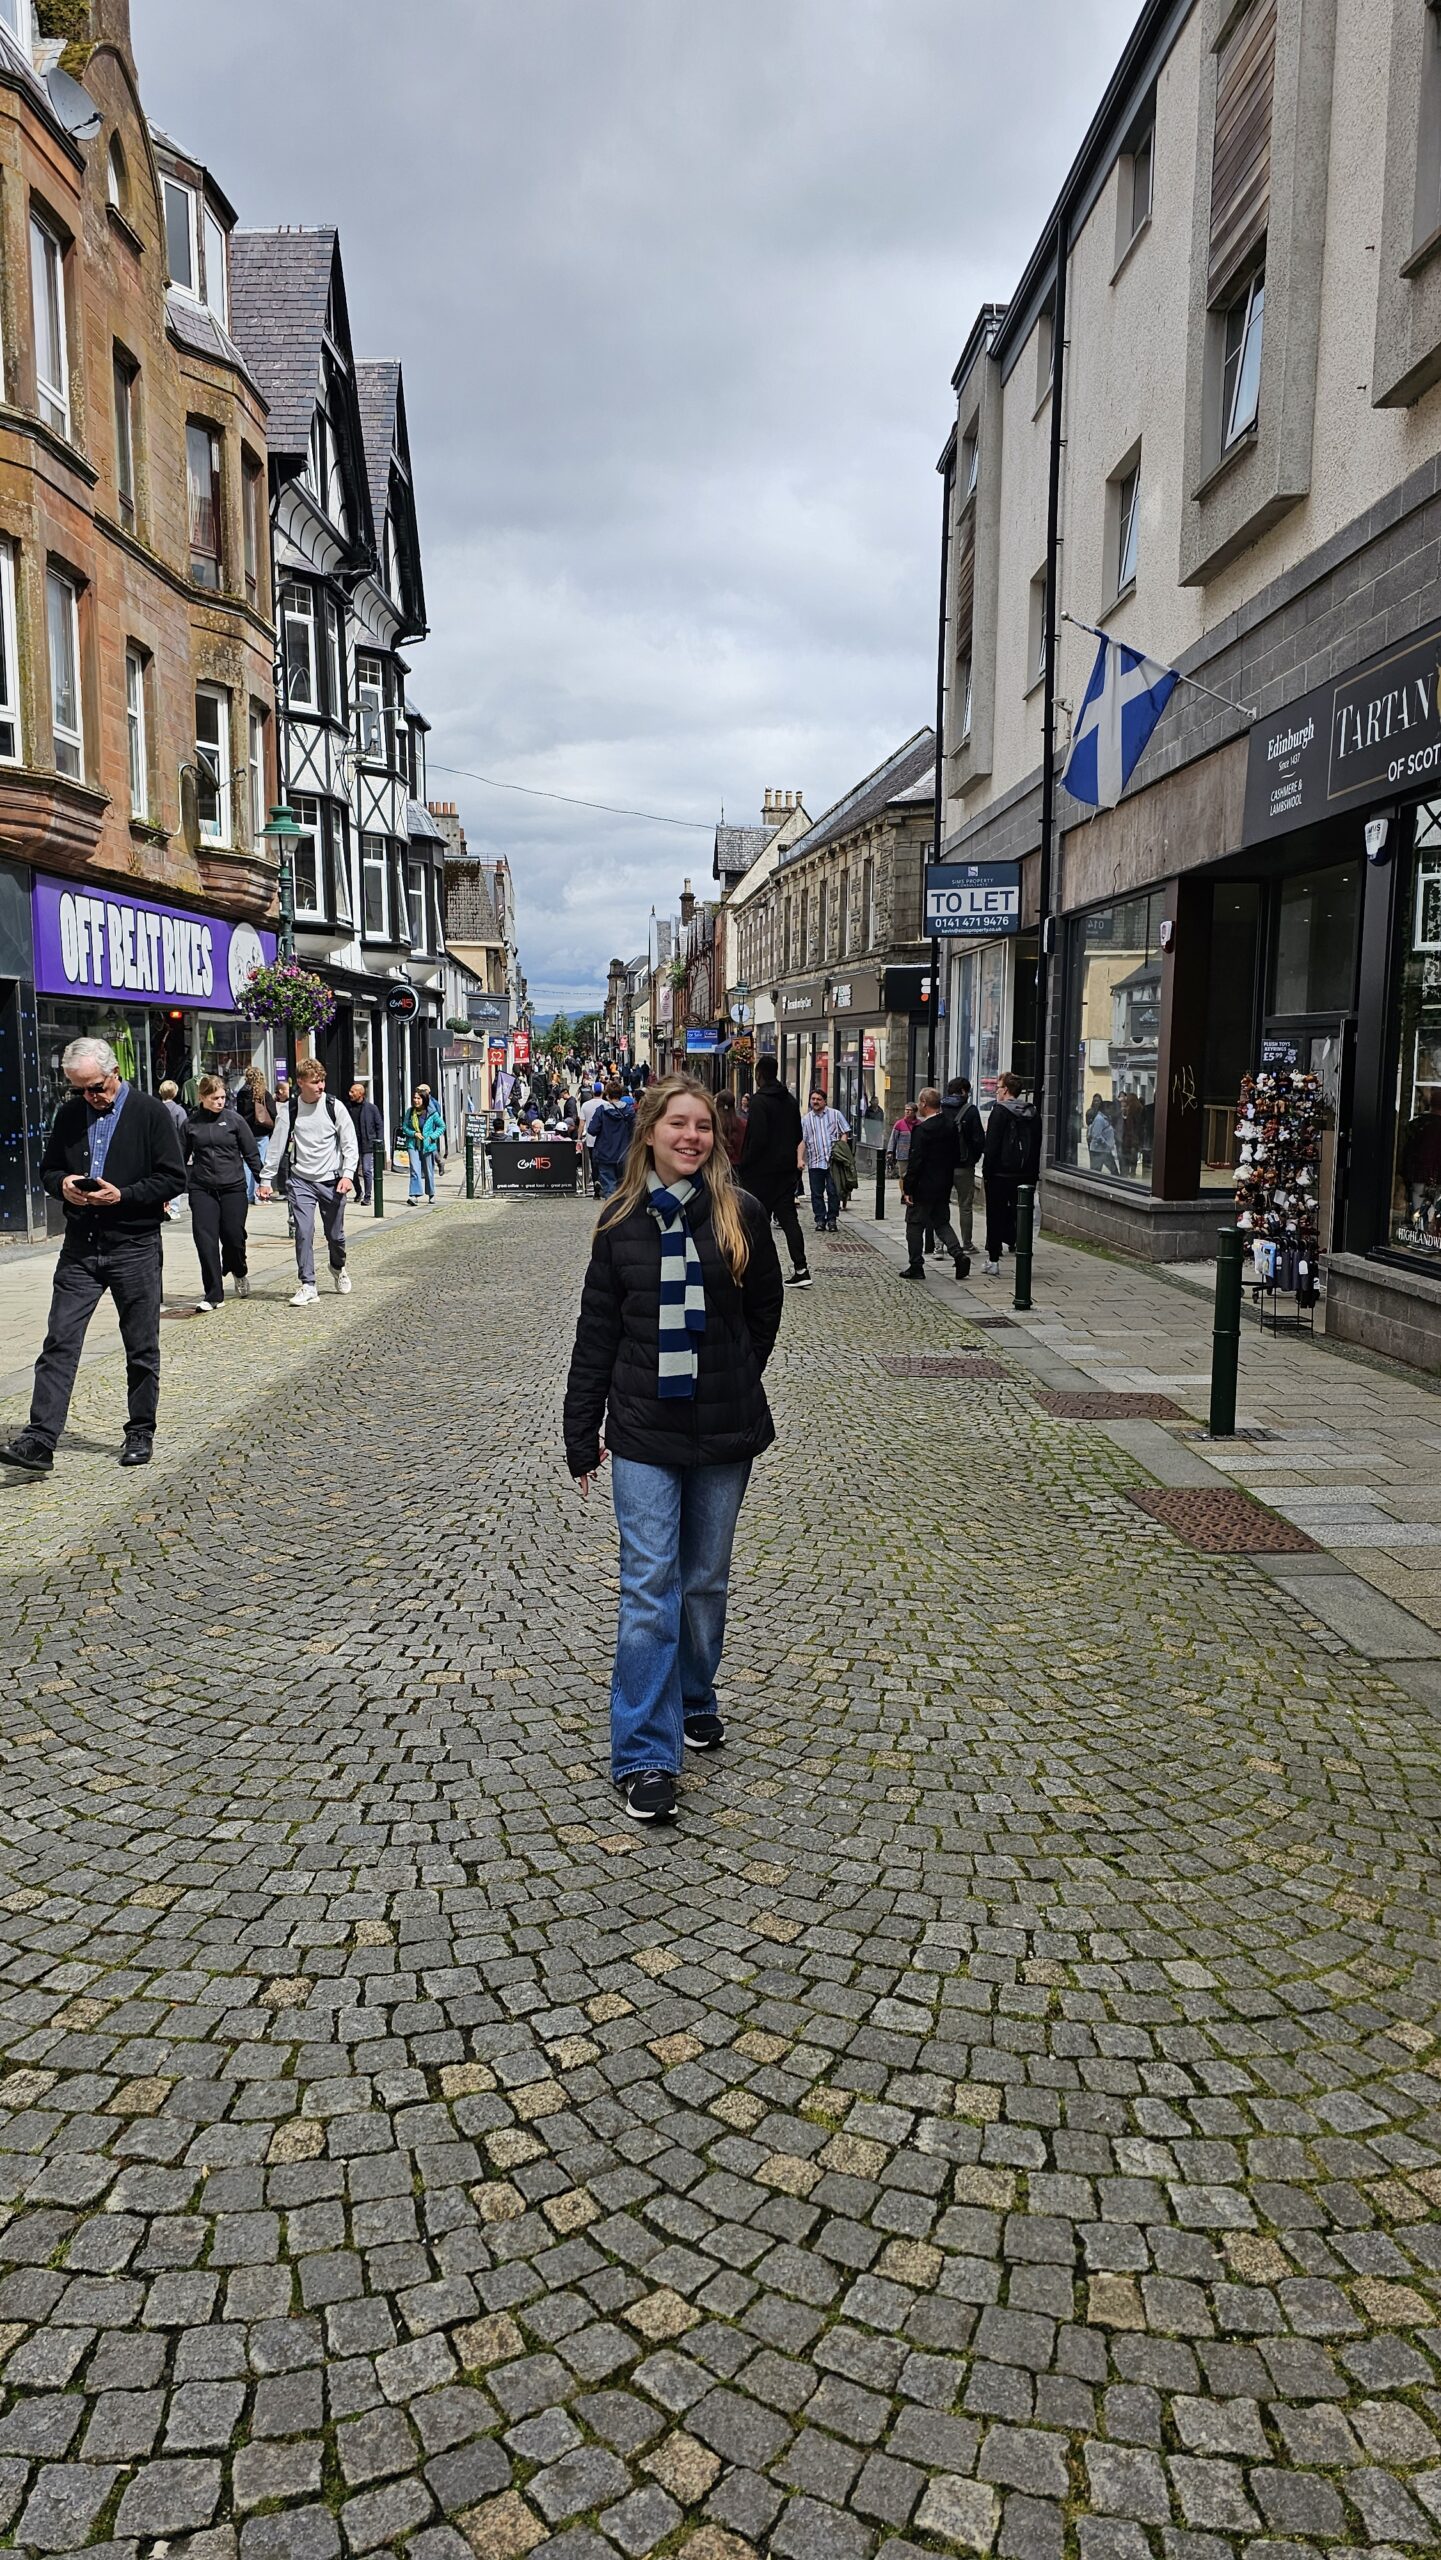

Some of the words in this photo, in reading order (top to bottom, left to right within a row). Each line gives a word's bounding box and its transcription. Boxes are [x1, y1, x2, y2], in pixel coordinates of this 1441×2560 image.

[1336, 673, 1434, 760] TARTAN
[1267, 717, 1314, 762] Edinburgh
[1278, 760, 1290, 772] Since
[1290, 752, 1301, 766] 1437
[1388, 757, 1405, 782] OF
[1407, 742, 1441, 775] SCOT
[1270, 780, 1298, 802] CASHMERE
[1298, 778, 1303, 791] &
[1269, 793, 1302, 817] LAMBSWOOL
[931, 892, 962, 913] TO
[970, 890, 1015, 912] LET
[935, 918, 959, 928] 0141
[962, 917, 980, 927] 471
[983, 916, 1009, 926] 9476
[59, 891, 105, 985] OFF
[107, 902, 160, 992] BEAT
[161, 915, 213, 997] BIKES
